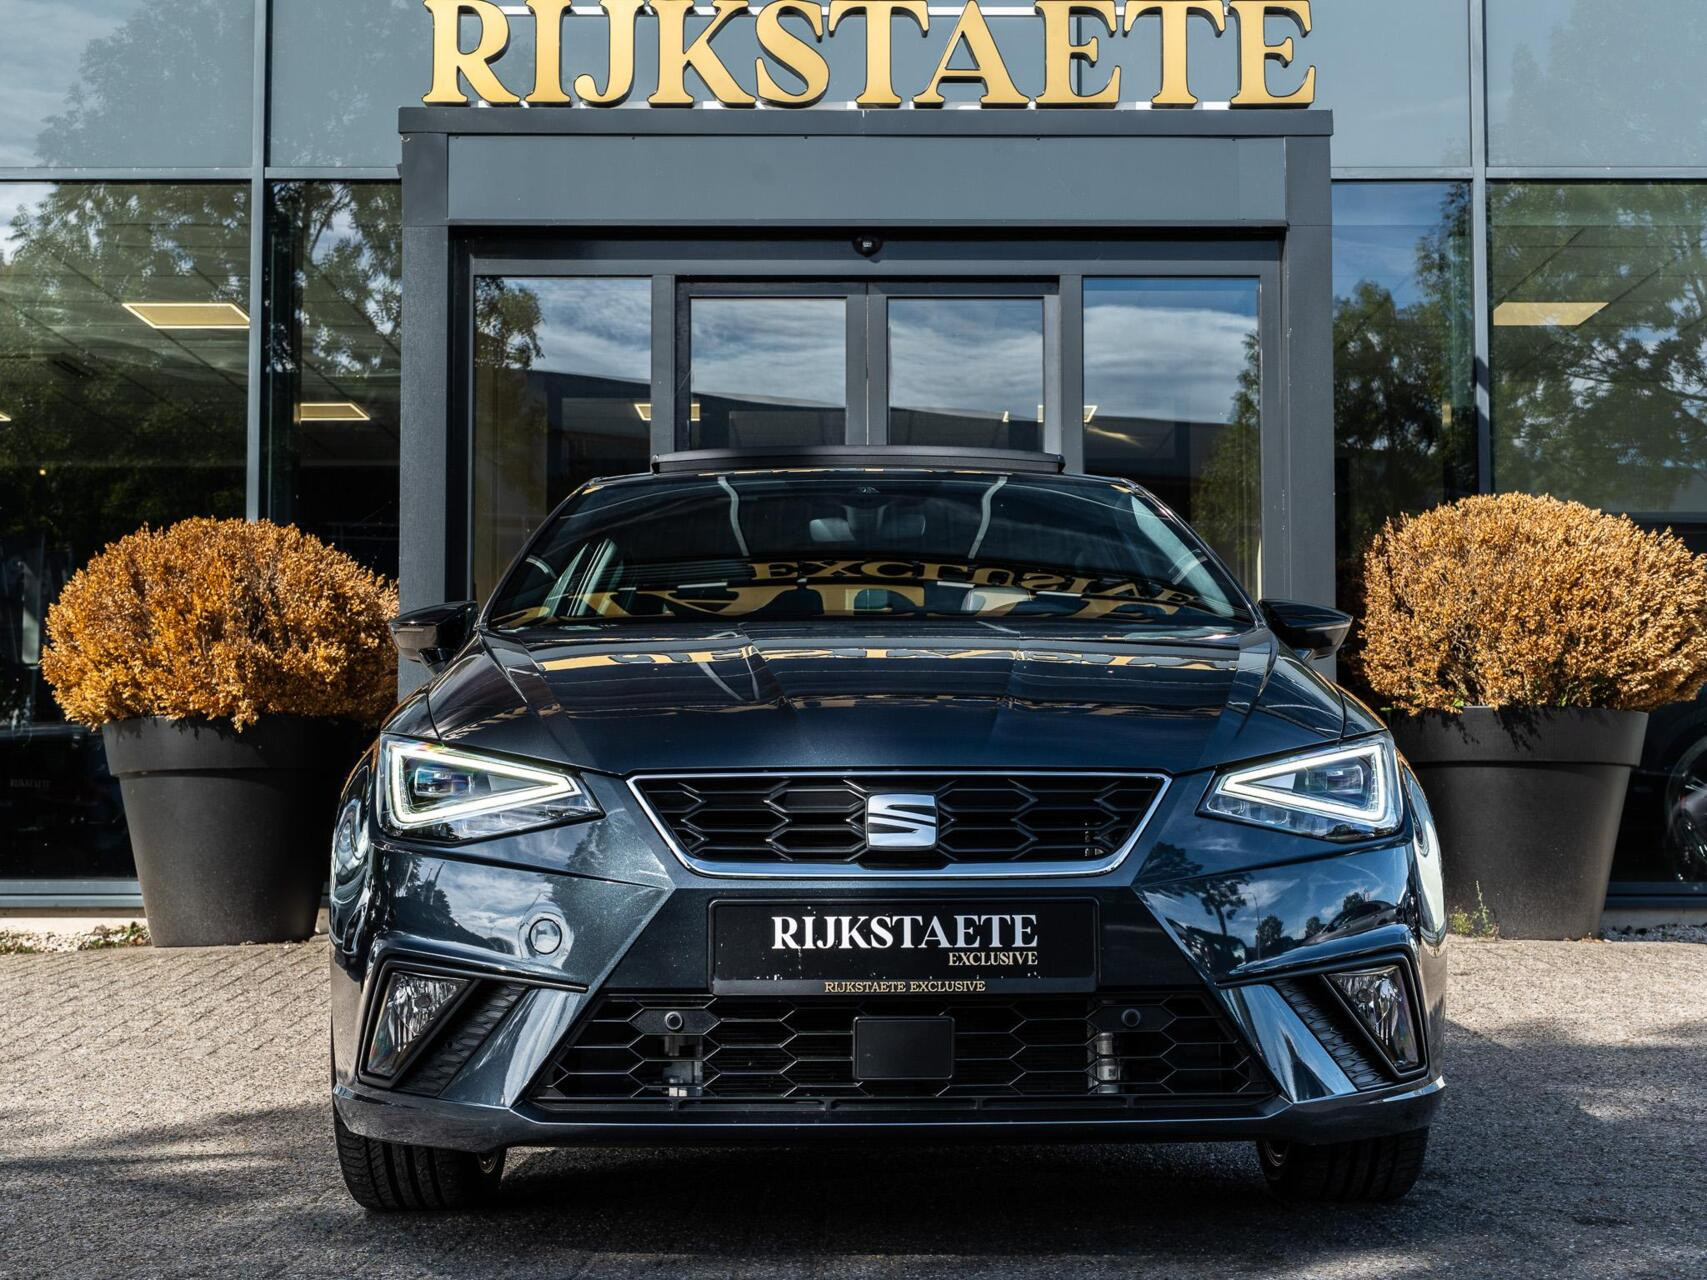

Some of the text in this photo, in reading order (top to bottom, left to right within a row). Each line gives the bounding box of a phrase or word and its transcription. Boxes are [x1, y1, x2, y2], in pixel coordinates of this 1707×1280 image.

[422, 0, 1316, 108] RIJKSTAETE
[771, 914, 1038, 949] RIJKSTAETE
[948, 951, 1038, 966] EXCLUSIVE
[824, 980, 986, 993] RIJKSTAETE EXCLUSIVE
